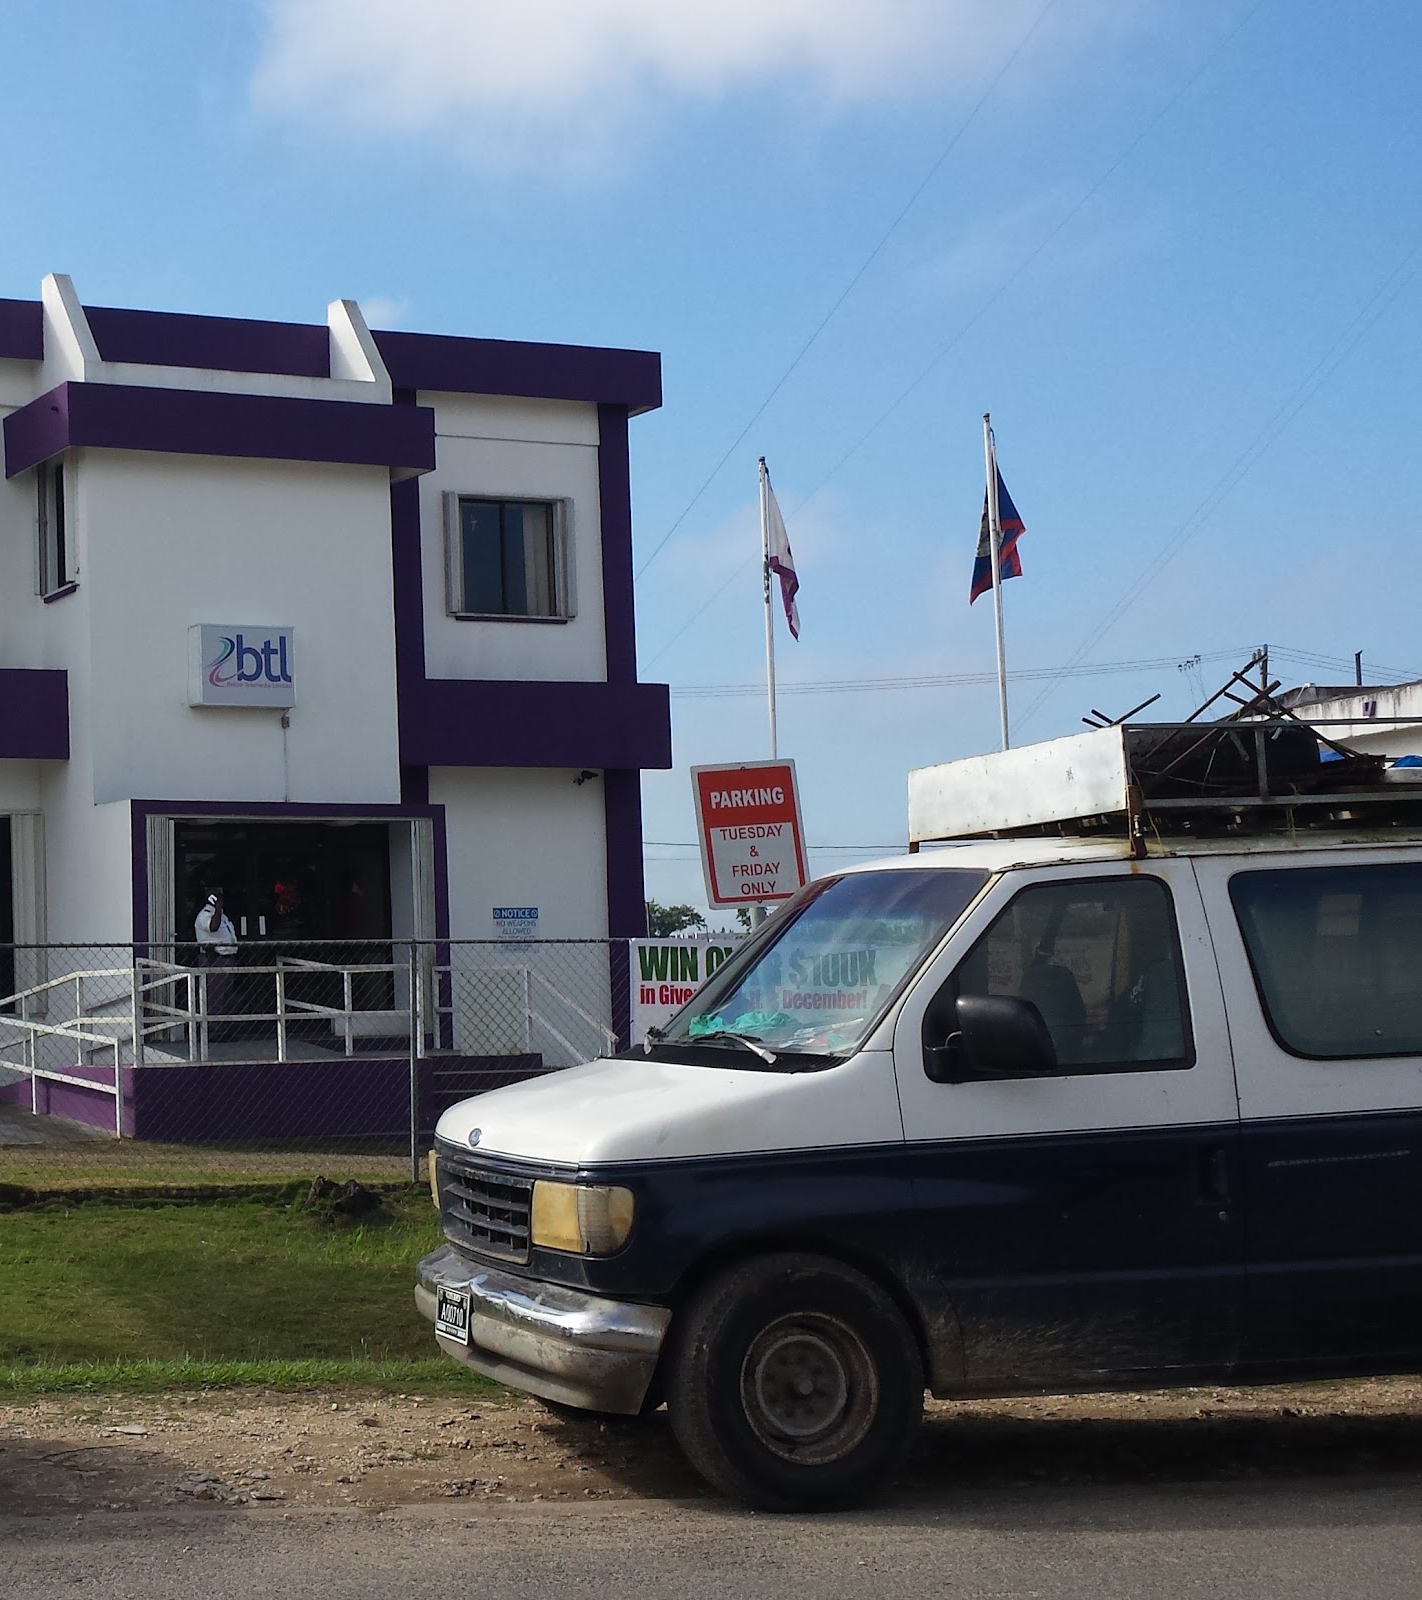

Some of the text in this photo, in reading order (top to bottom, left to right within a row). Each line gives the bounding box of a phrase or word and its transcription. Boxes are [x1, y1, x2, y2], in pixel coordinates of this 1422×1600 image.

[236, 634, 292, 682] btl
[710, 787, 784, 809] PARKING
[720, 824, 783, 841] TUESDAY
[749, 845, 759, 857] &
[732, 862, 780, 877] FRIDAY
[741, 881, 776, 895] ONLY
[501, 909, 530, 918] NOTICE
[638, 946, 698, 981] WIN
[640, 985, 656, 1004] in
[783, 990, 868, 1010] December!
